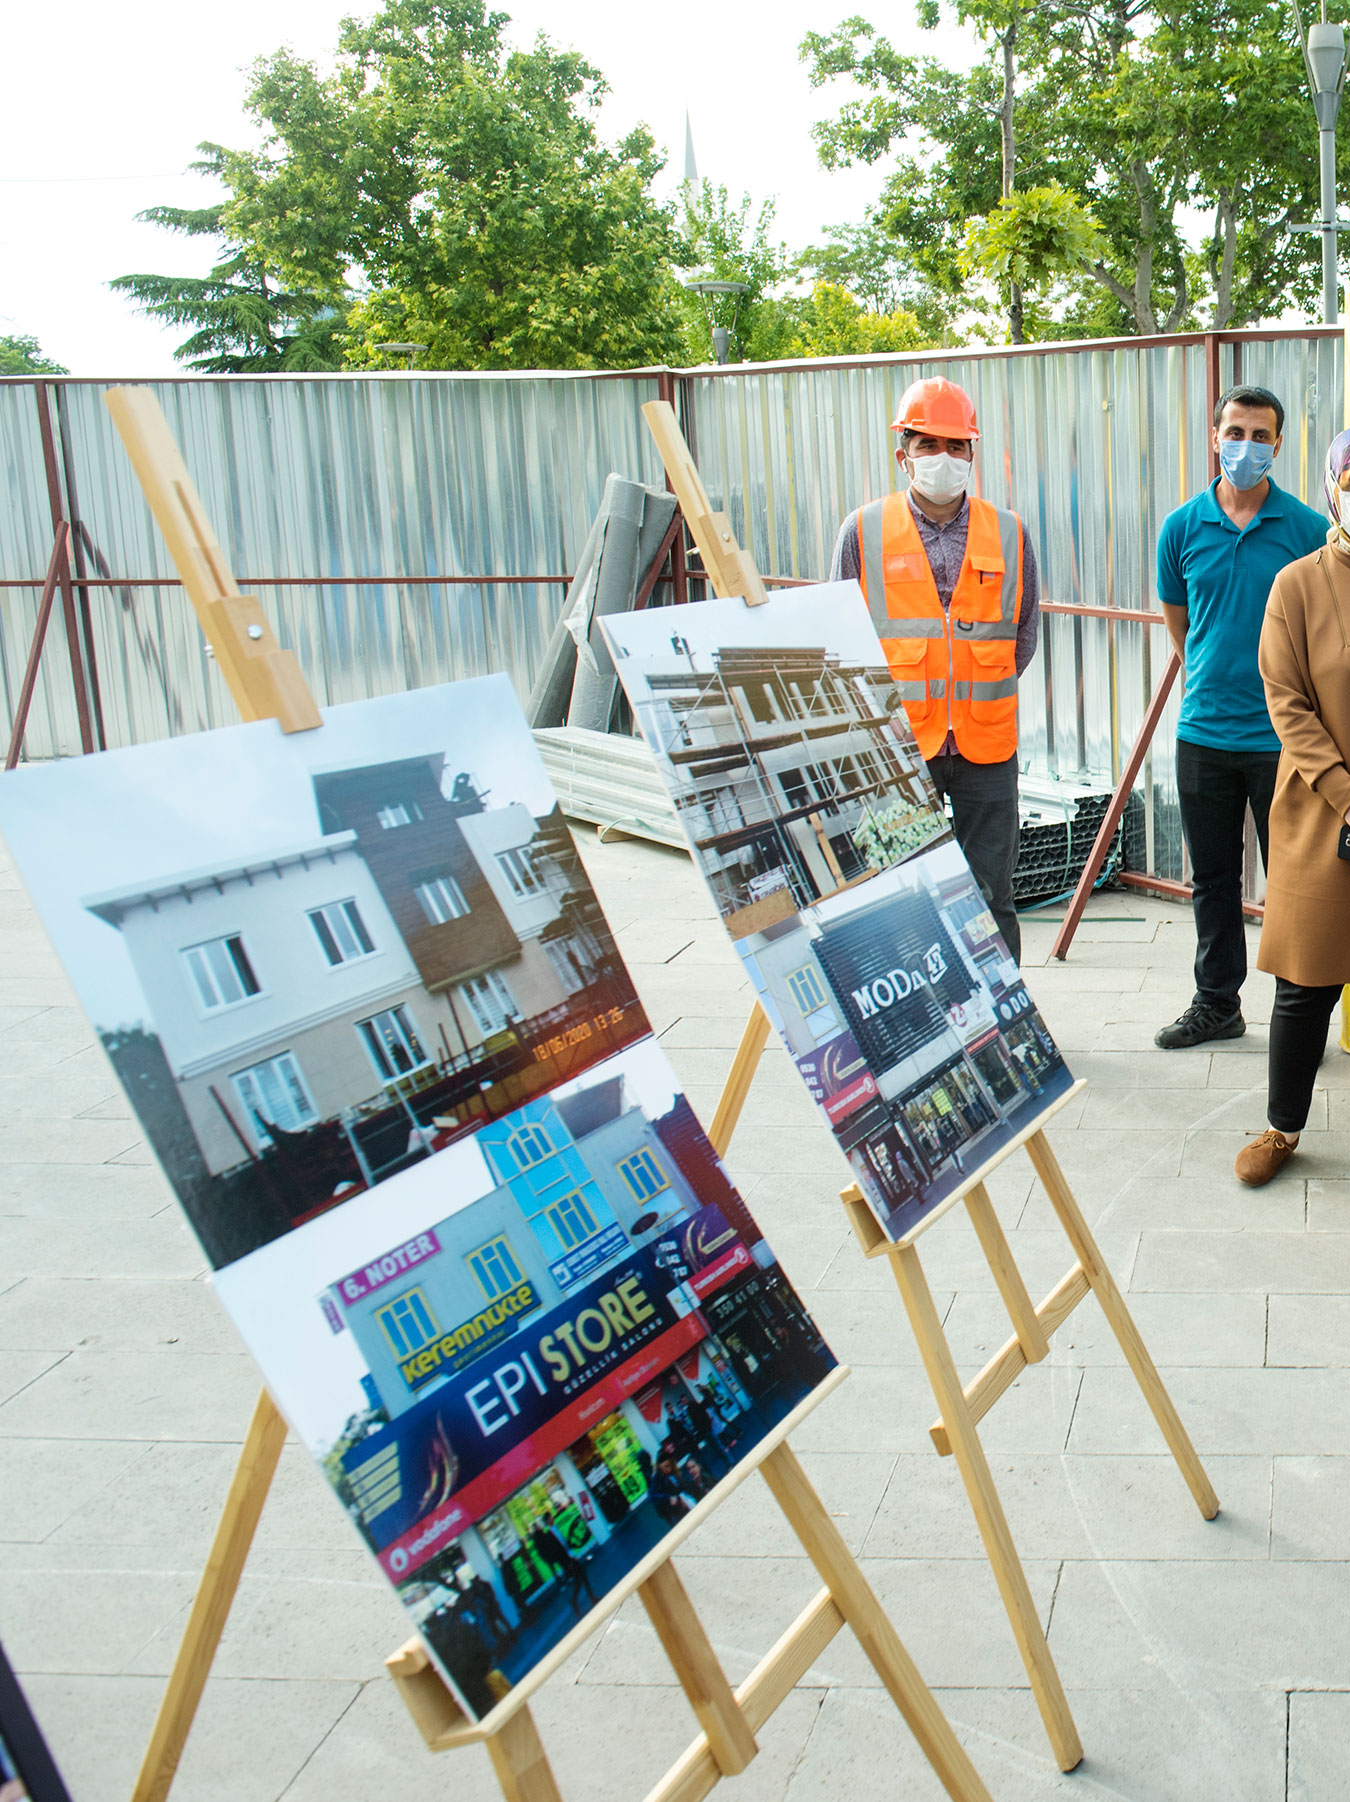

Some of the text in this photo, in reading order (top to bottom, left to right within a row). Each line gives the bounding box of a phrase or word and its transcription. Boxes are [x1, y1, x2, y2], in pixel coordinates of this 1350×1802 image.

[342, 1234, 434, 1299] 6. NOTER
[464, 1276, 656, 1438] EPI STORE
